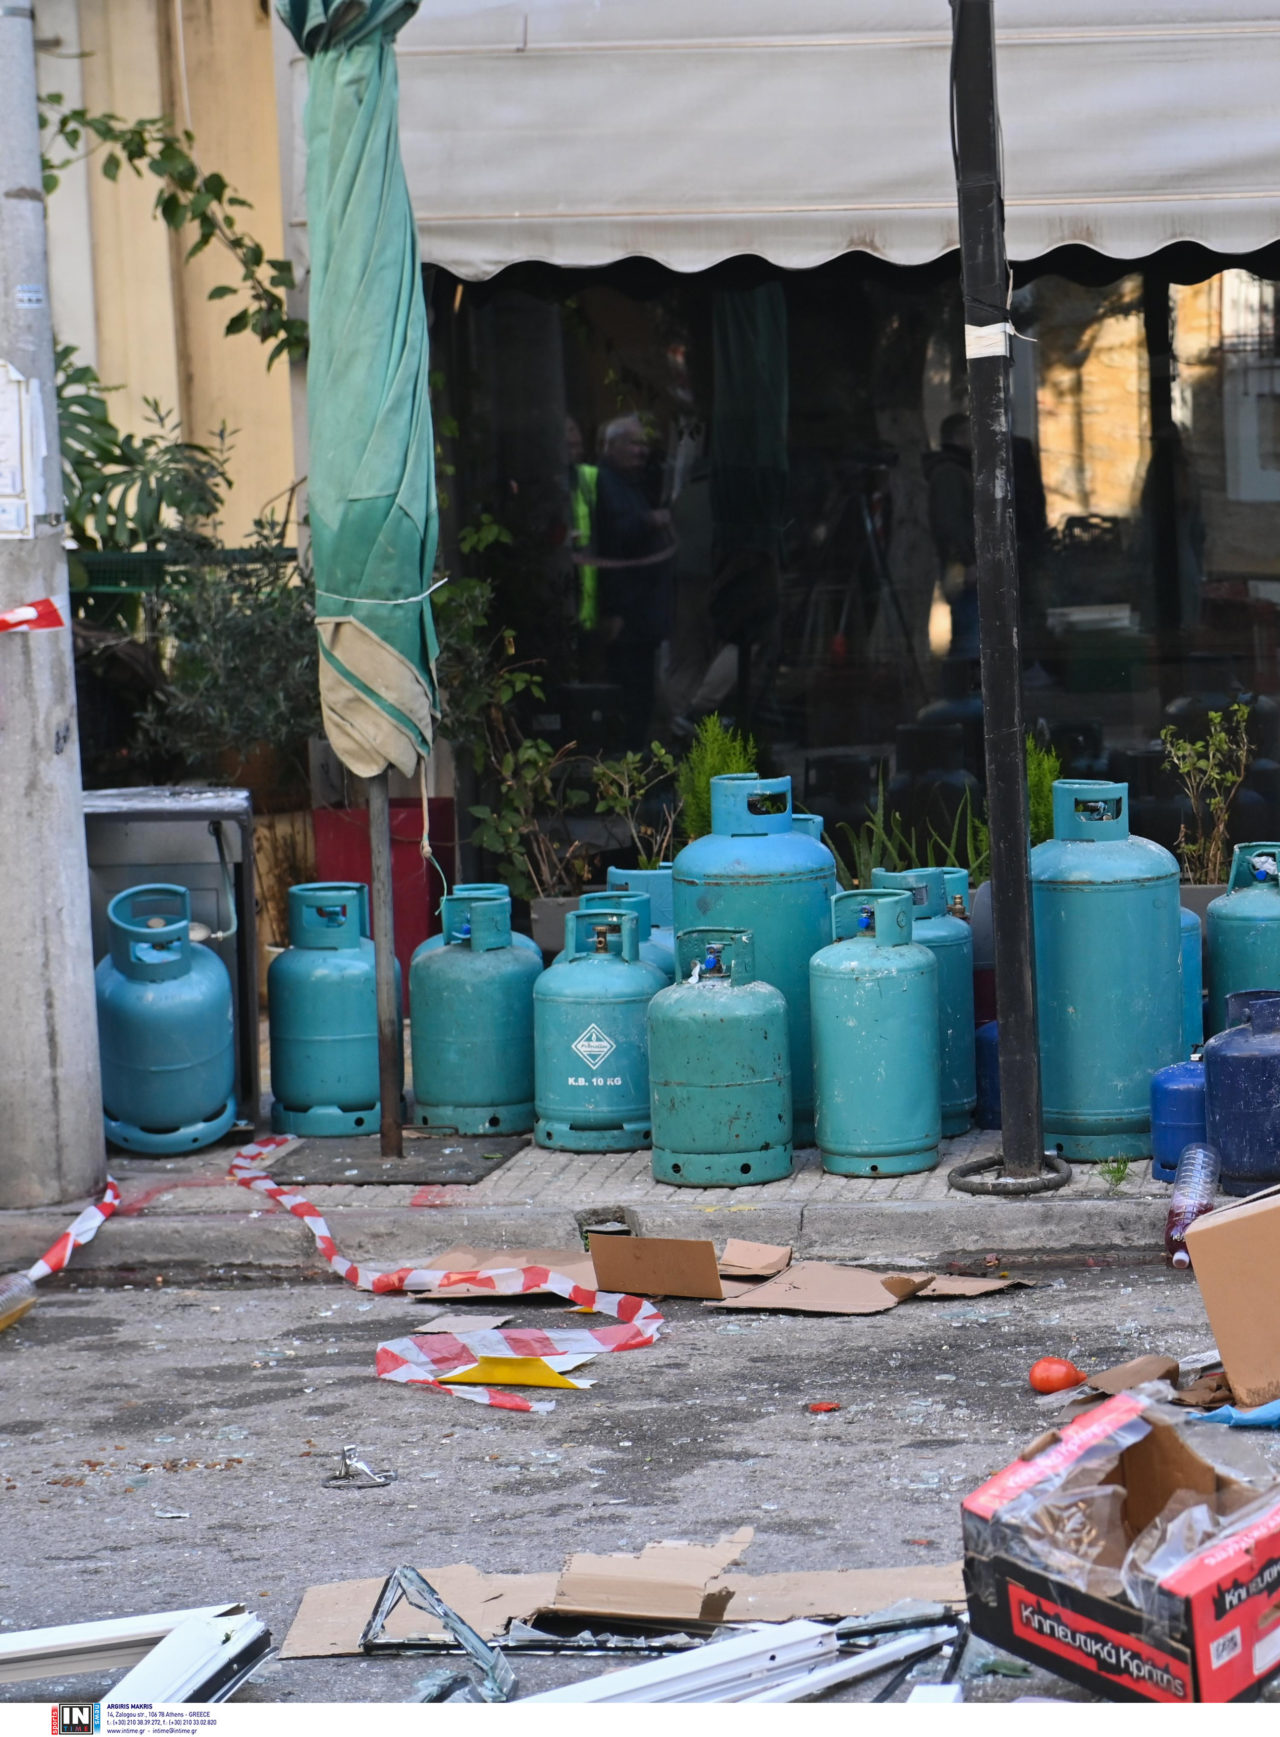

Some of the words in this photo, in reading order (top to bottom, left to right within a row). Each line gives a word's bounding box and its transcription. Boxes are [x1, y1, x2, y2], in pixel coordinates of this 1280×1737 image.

[592, 1077, 604, 1086] 10
[607, 1077, 622, 1086] KG
[1021, 1603, 1117, 1665] Κηπευτικά
[1119, 1647, 1184, 1697] Κρήτης
